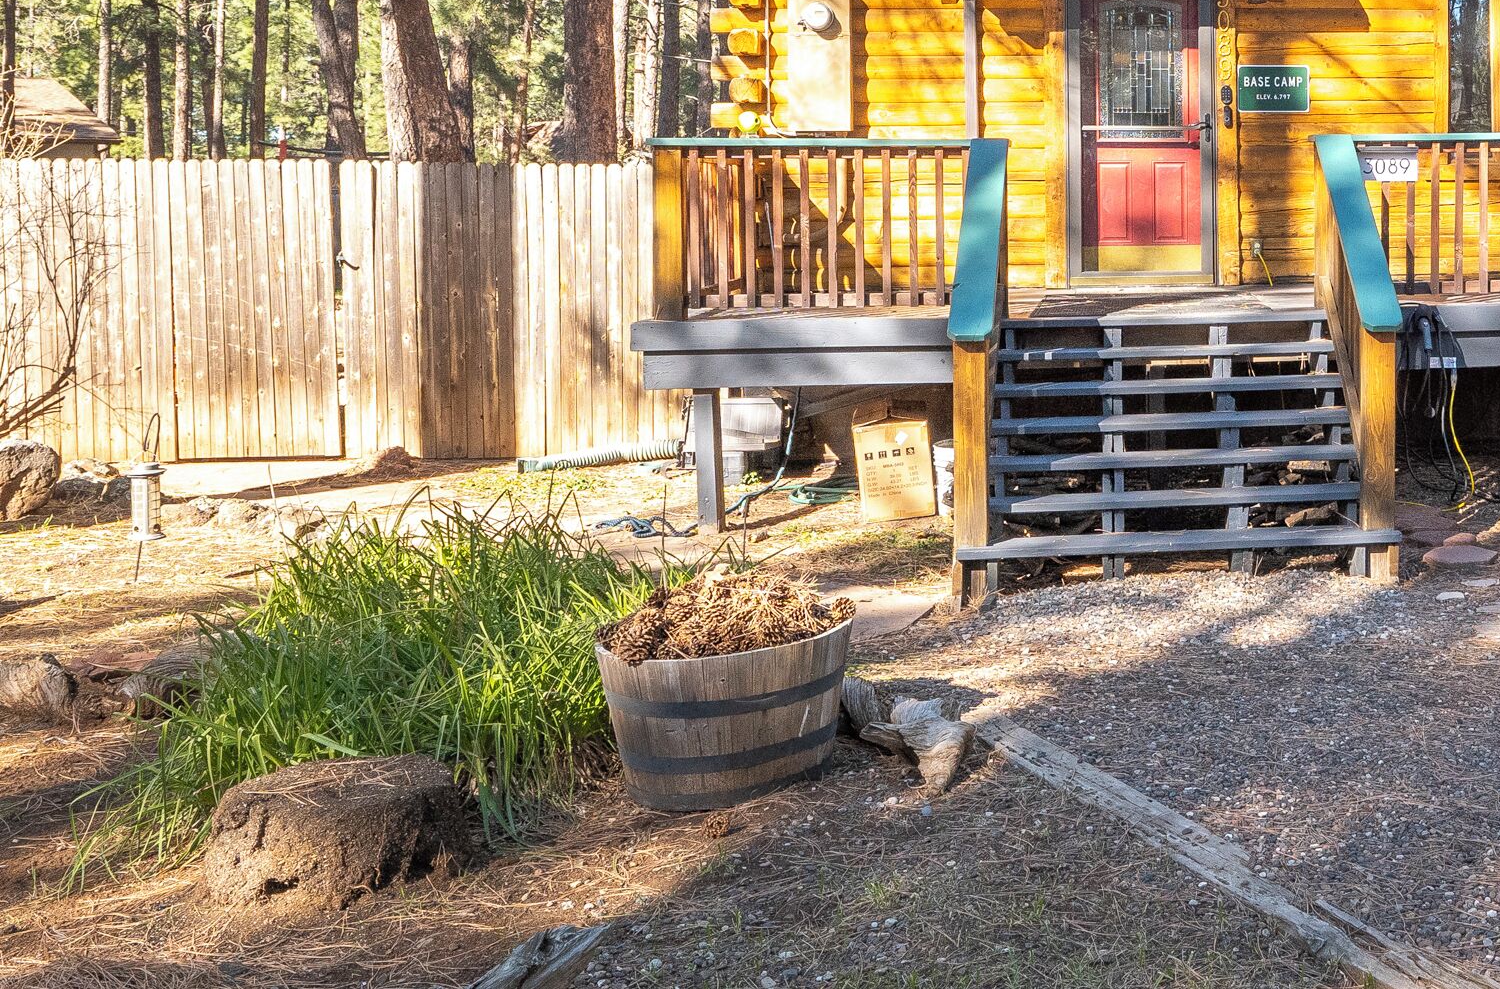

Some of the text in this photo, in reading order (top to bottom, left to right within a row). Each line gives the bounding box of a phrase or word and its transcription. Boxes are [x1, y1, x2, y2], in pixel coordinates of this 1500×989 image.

[1243, 76, 1303, 88] BASE CAMP
[1362, 157, 1411, 174] 3089
